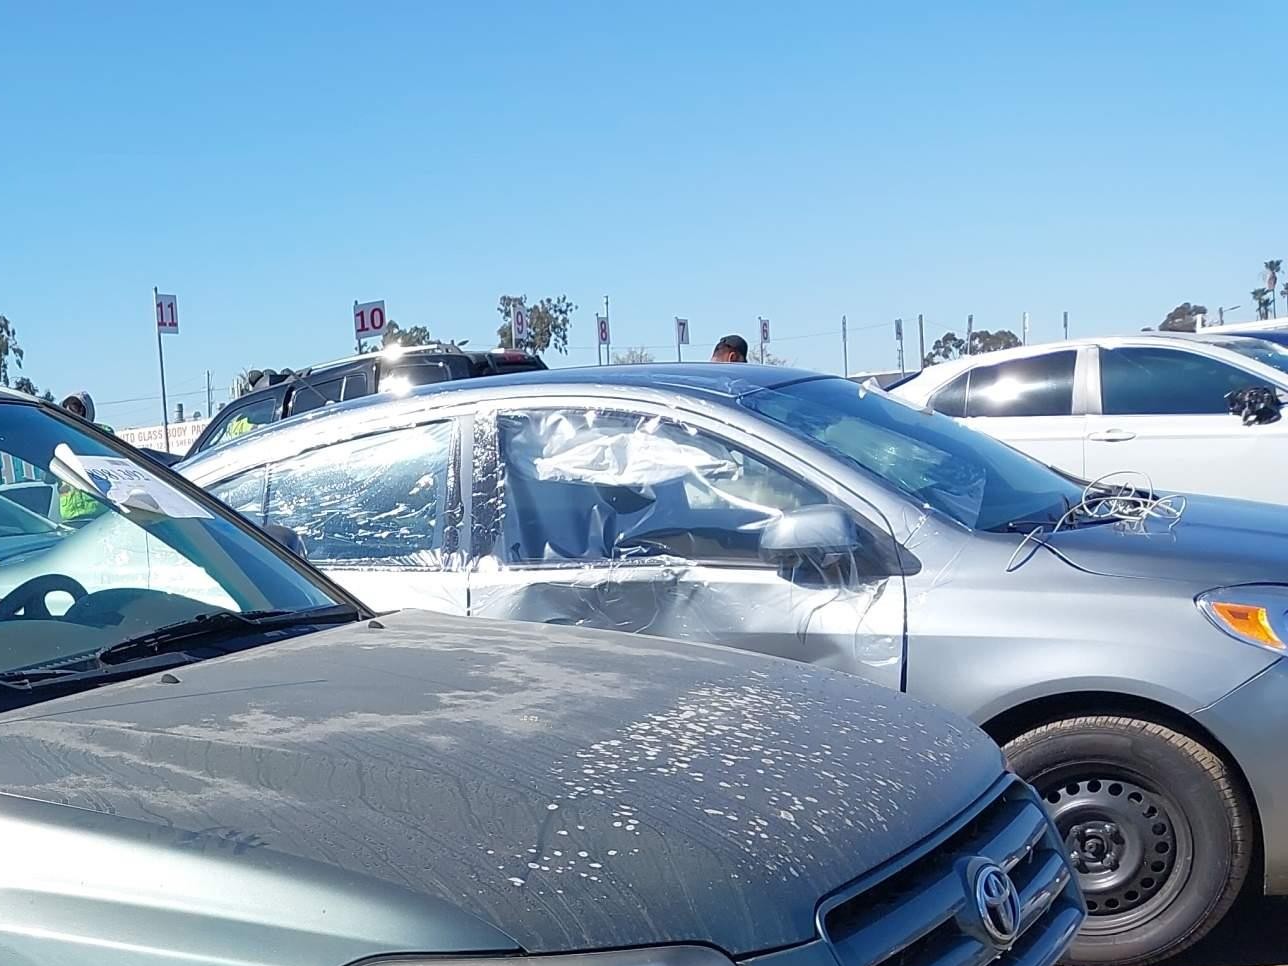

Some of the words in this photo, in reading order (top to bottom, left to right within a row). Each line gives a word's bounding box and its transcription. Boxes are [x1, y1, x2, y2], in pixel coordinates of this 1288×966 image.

[156, 301, 178, 328] 11
[355, 307, 385, 333] 10
[516, 310, 524, 335] 9
[599, 320, 608, 342] 8
[678, 321, 687, 343] 7
[762, 322, 769, 340] 6
[138, 429, 163, 443] GLASS
